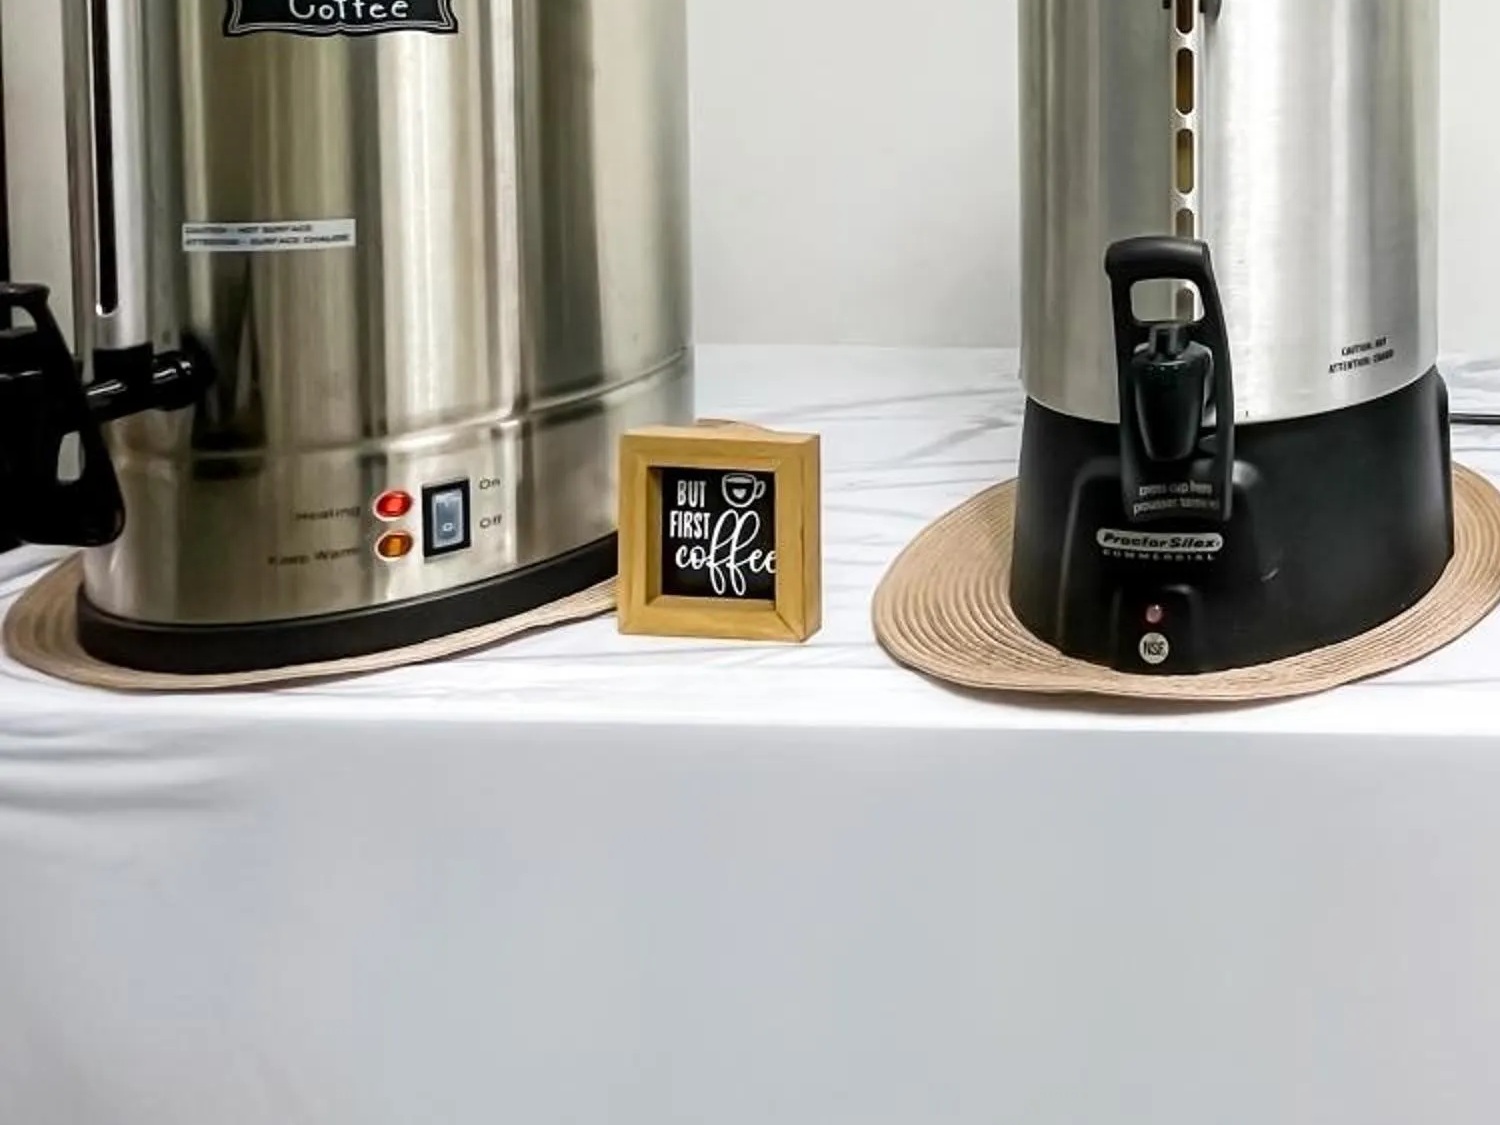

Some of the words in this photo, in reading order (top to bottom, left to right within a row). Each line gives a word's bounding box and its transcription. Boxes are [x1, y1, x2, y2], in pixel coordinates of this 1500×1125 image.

[479, 477, 501, 490] On
[677, 479, 707, 508] BUT
[479, 514, 503, 529] Off
[669, 510, 711, 540] FIRST
